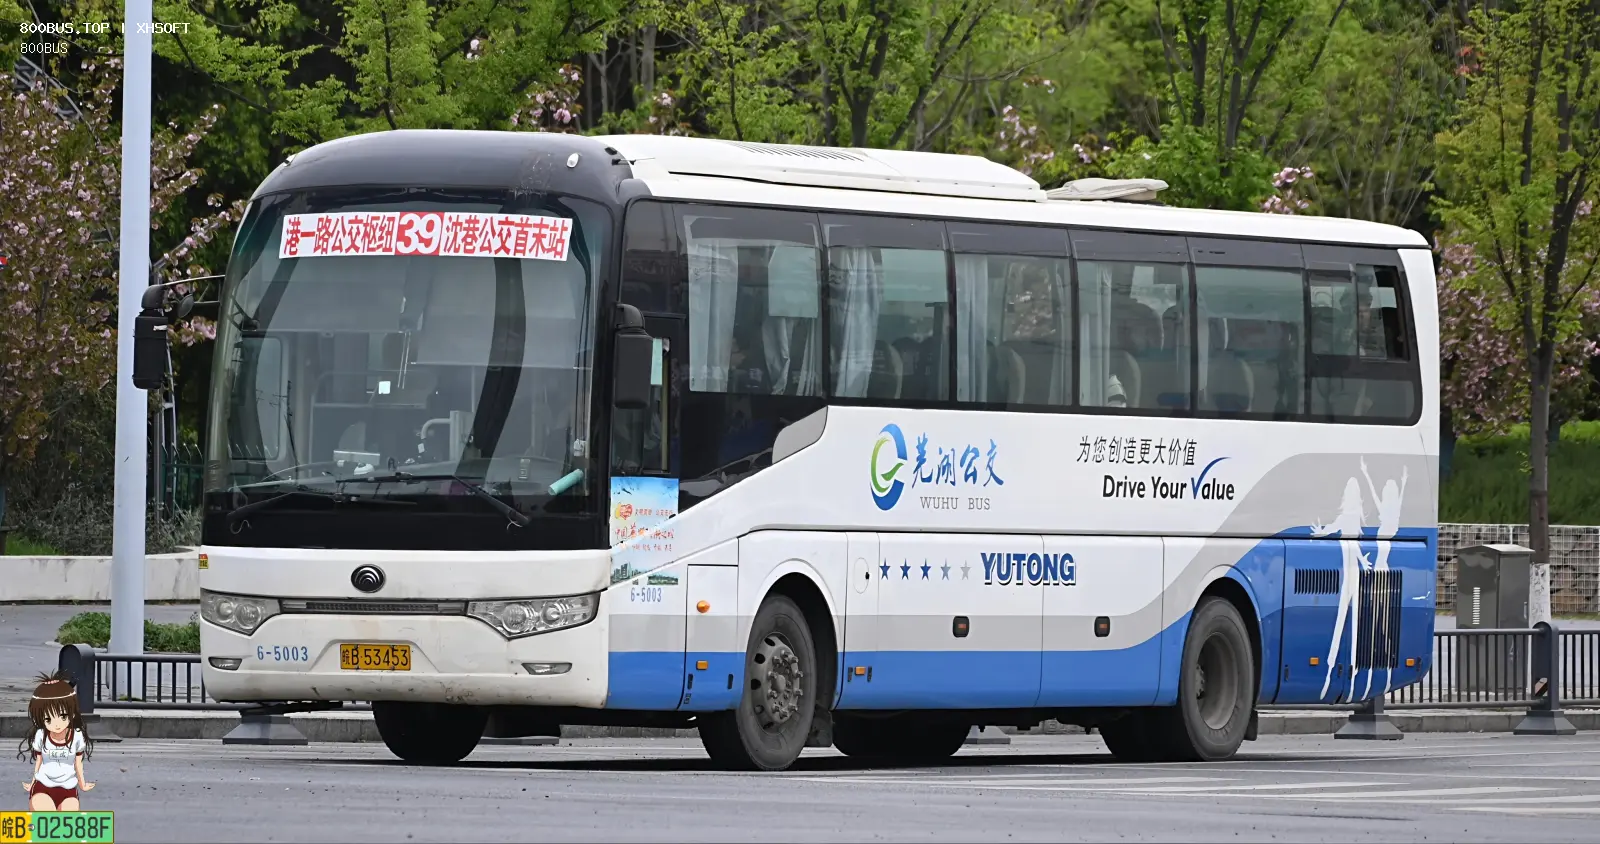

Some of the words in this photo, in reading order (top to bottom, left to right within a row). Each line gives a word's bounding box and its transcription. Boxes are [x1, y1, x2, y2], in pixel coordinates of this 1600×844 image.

[283, 214, 396, 255] 港一路公交枢纽
[396, 213, 443, 255] 39
[444, 215, 569, 259] 沈巷公交首末站
[911, 432, 1005, 489] 芜湖公交
[1076, 435, 1197, 466] 为您创造更大价值
[1102, 475, 1146, 499] Drive
[1151, 476, 1187, 499] Your
[1190, 456, 1235, 501] Value
[920, 496, 959, 510] WUHU
[968, 497, 991, 511] BUS
[980, 552, 1077, 586] YUTONG
[630, 587, 662, 602] 6-5003
[256, 645, 309, 662] 6-5003
